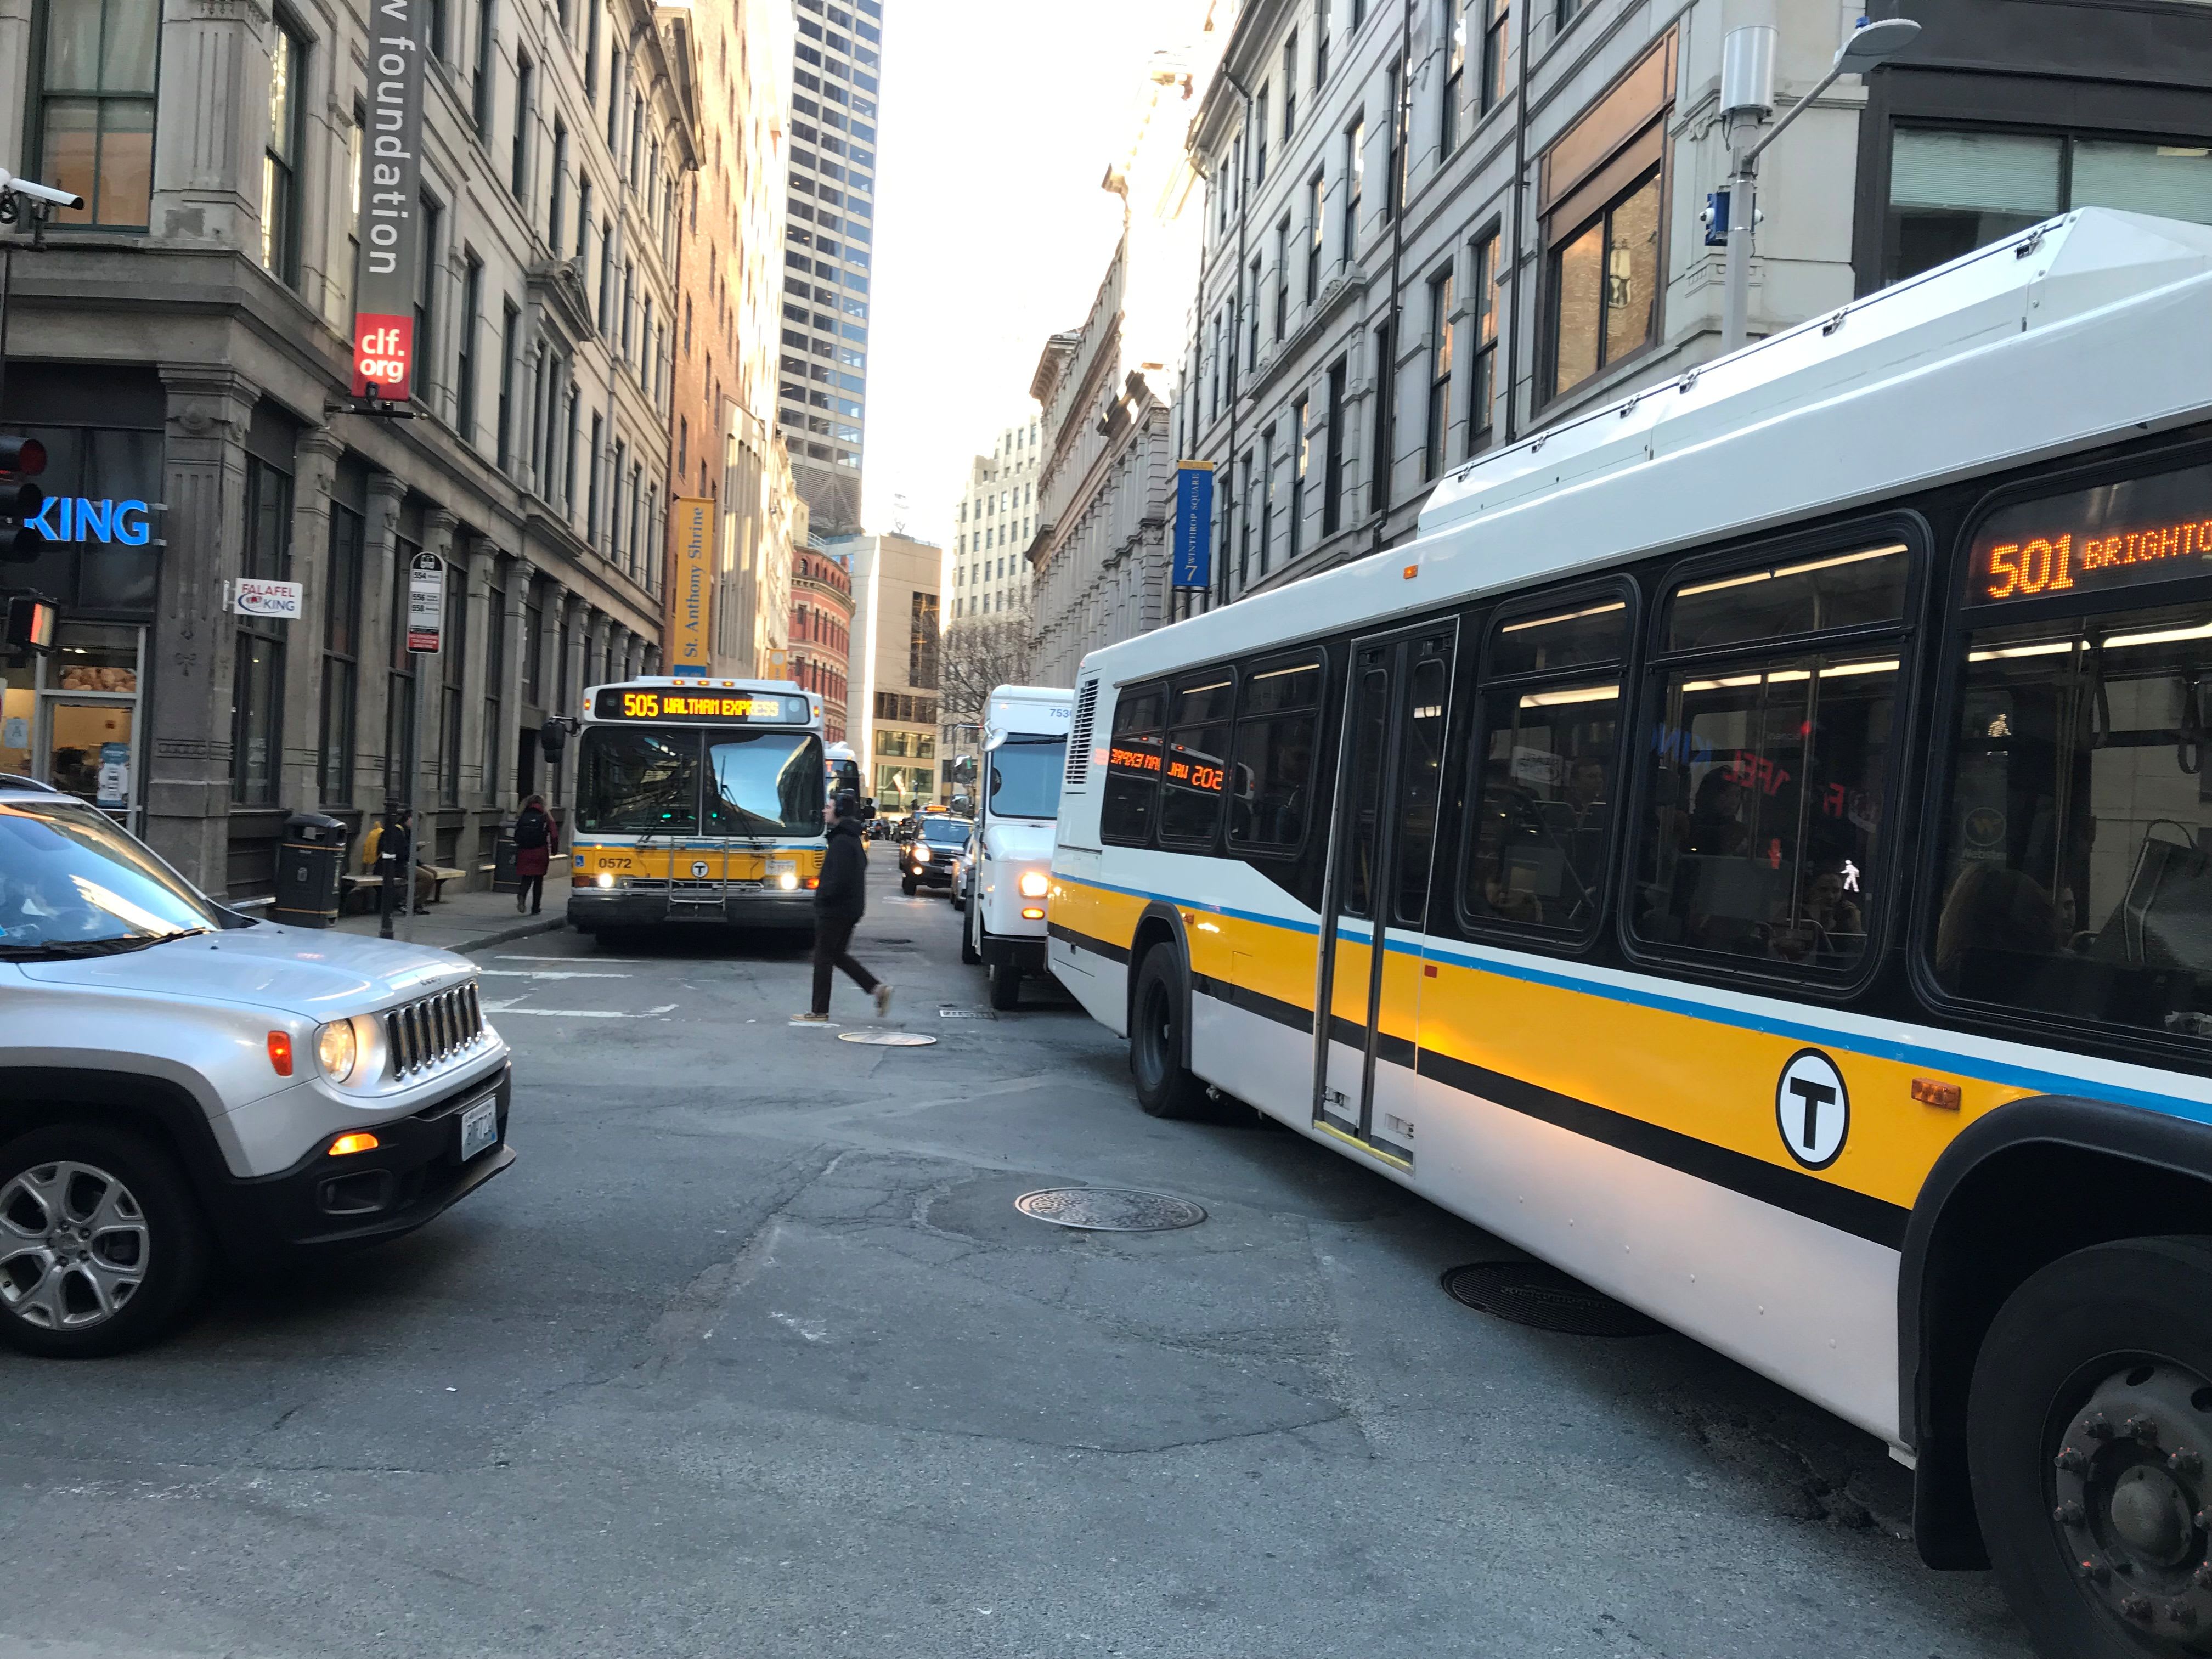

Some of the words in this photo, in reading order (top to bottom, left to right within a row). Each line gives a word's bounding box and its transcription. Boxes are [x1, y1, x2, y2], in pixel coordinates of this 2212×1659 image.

[369, 36, 416, 274] foundation
[361, 328, 405, 357] clf.
[359, 358, 404, 383] org
[1190, 473, 1200, 510] SQUARE
[688, 507, 703, 560] Shrine
[1187, 514, 1198, 565] WINTHROP
[1184, 565, 1198, 582] 7
[1988, 533, 2074, 599] 501
[241, 584, 295, 597] FALAFEL
[685, 566, 706, 632] Anthony
[263, 599, 295, 611] KING
[685, 638, 698, 657] St.
[624, 693, 659, 717] 505
[663, 697, 720, 715] WALTHAM
[721, 699, 780, 716] EXPRESS
[599, 858, 632, 868] 0572
[695, 865, 706, 875] T
[1790, 1076, 1836, 1150] T
